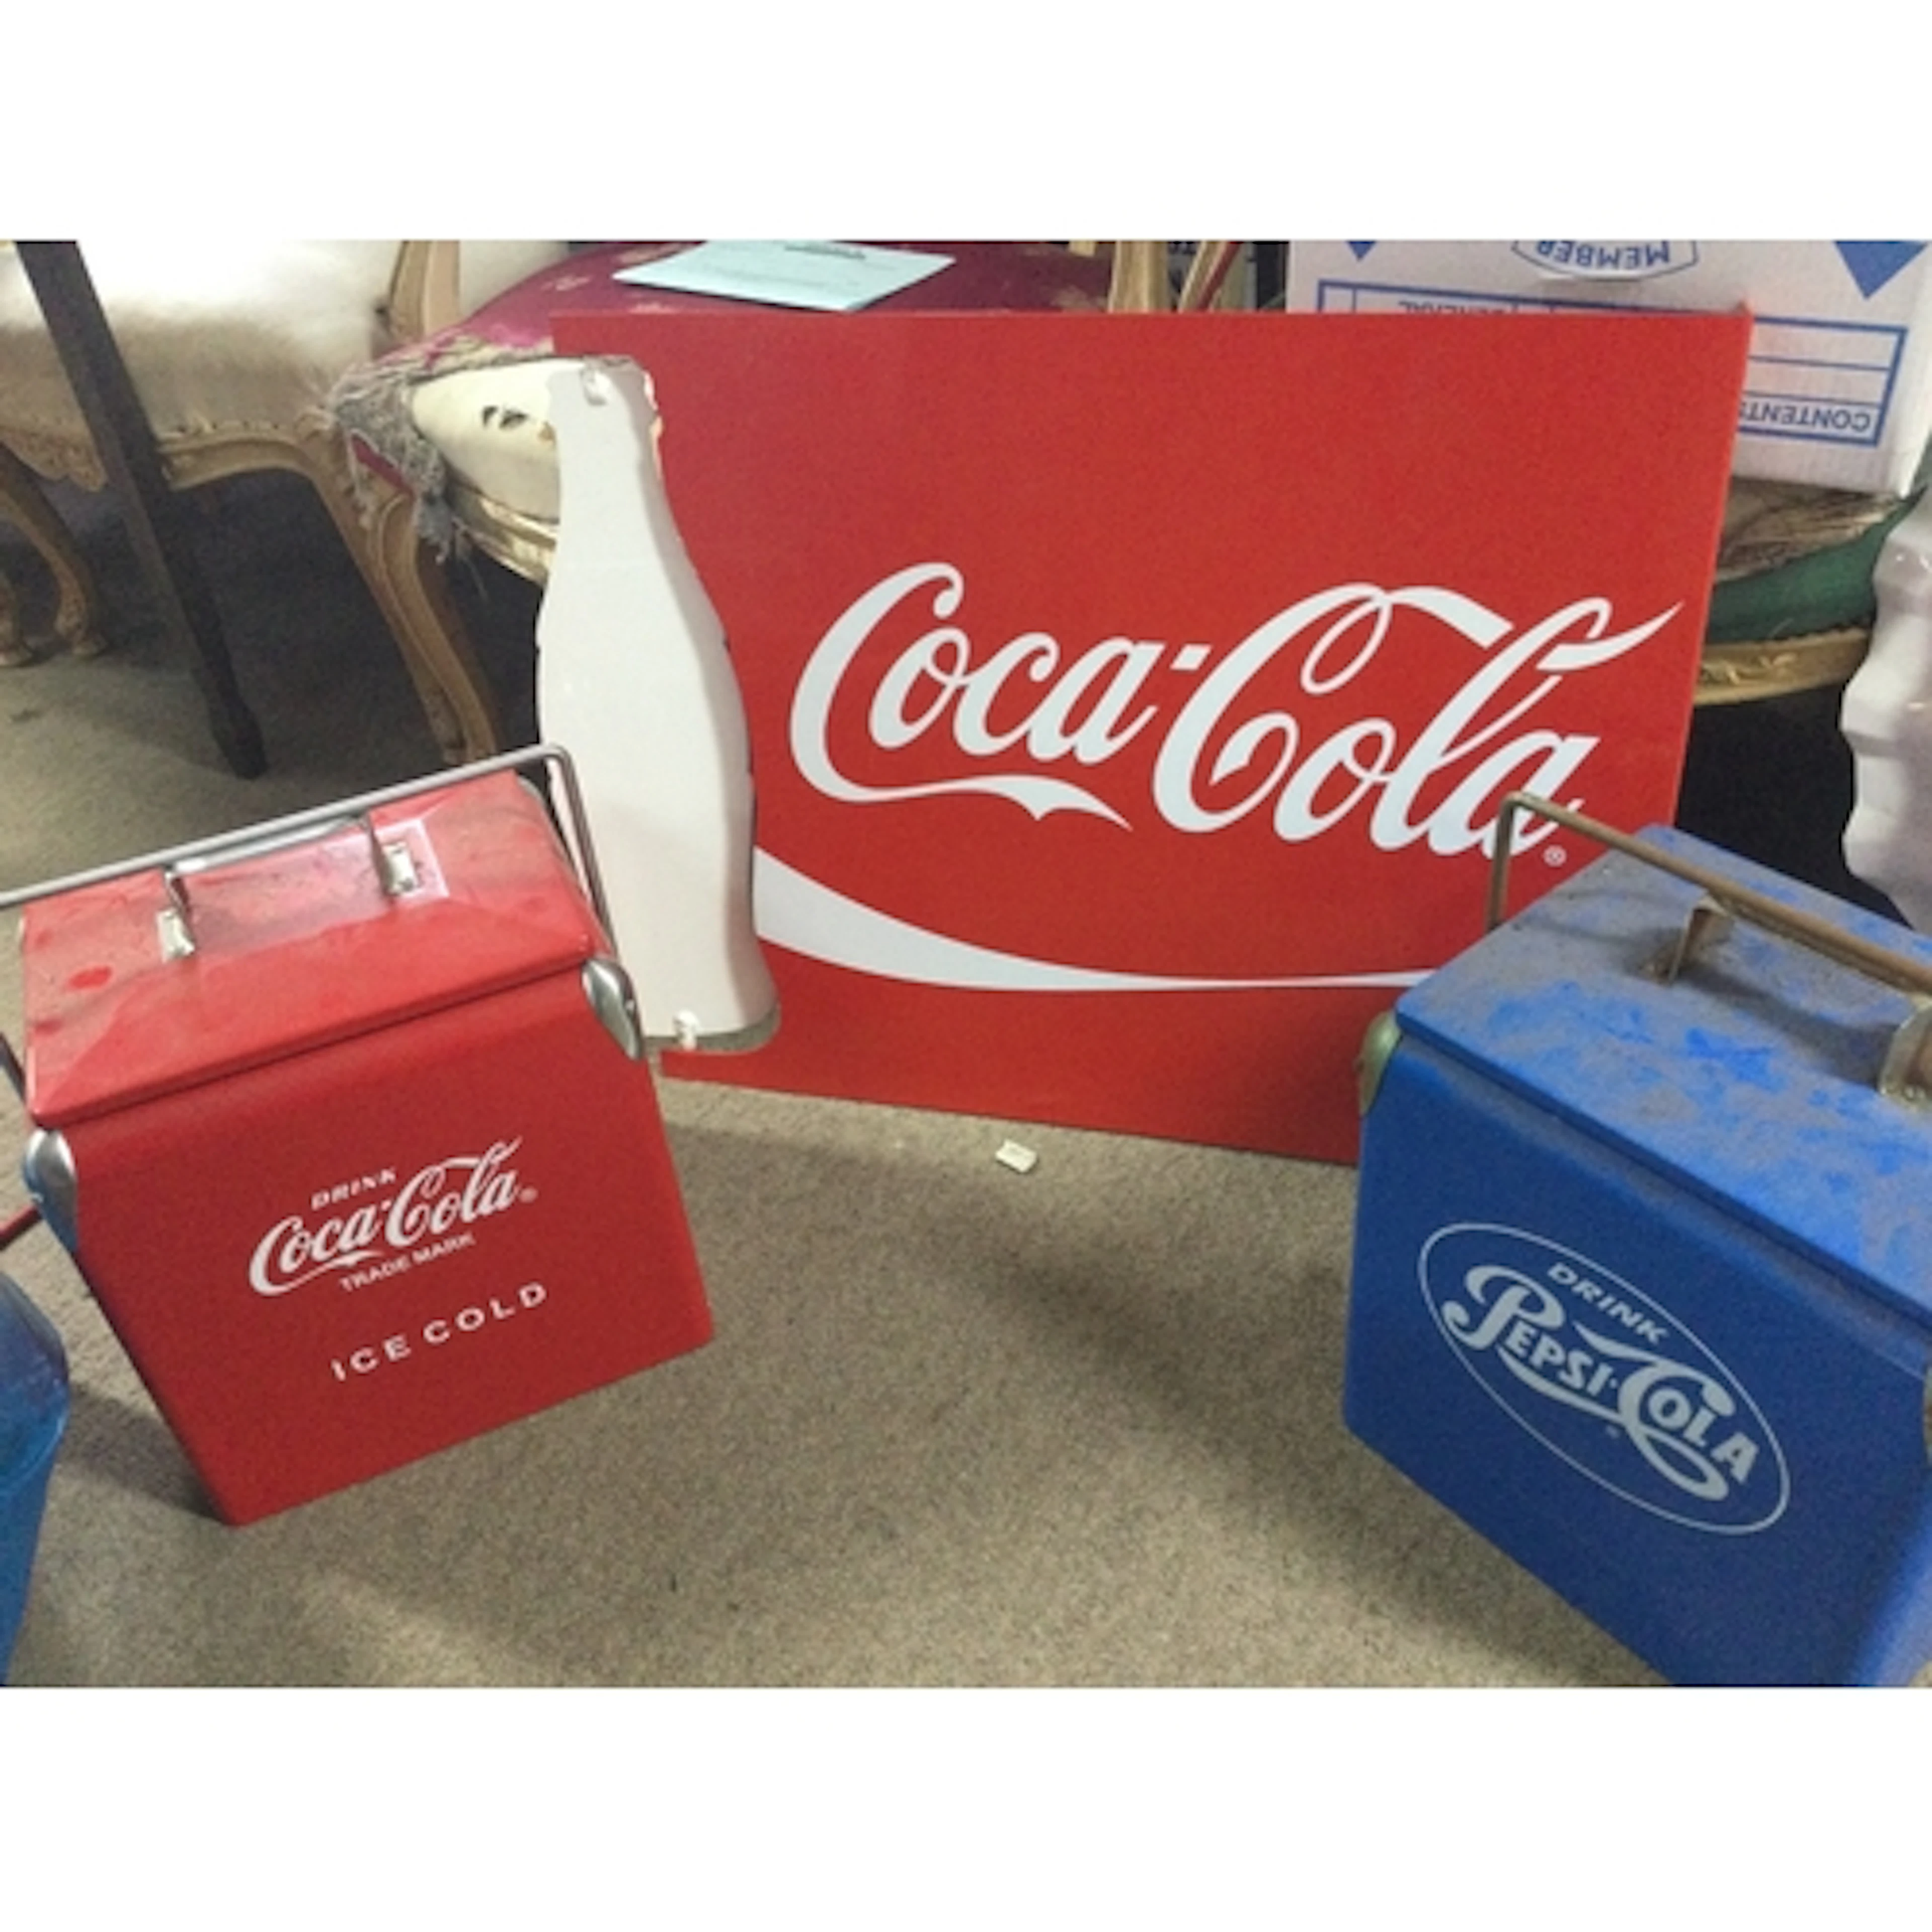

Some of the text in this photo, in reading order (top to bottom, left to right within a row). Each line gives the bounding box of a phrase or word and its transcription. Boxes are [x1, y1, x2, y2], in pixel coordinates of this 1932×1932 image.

[1536, 240, 1670, 269] MEMBER
[790, 562, 1681, 859] Coca-Cola
[249, 1135, 523, 1296] Coca-Cola
[311, 1167, 396, 1211] DRINK
[340, 1233, 475, 1292] TRADE MARK
[1547, 1262, 1669, 1345] DRINK
[331, 1282, 547, 1381] ICE COLD
